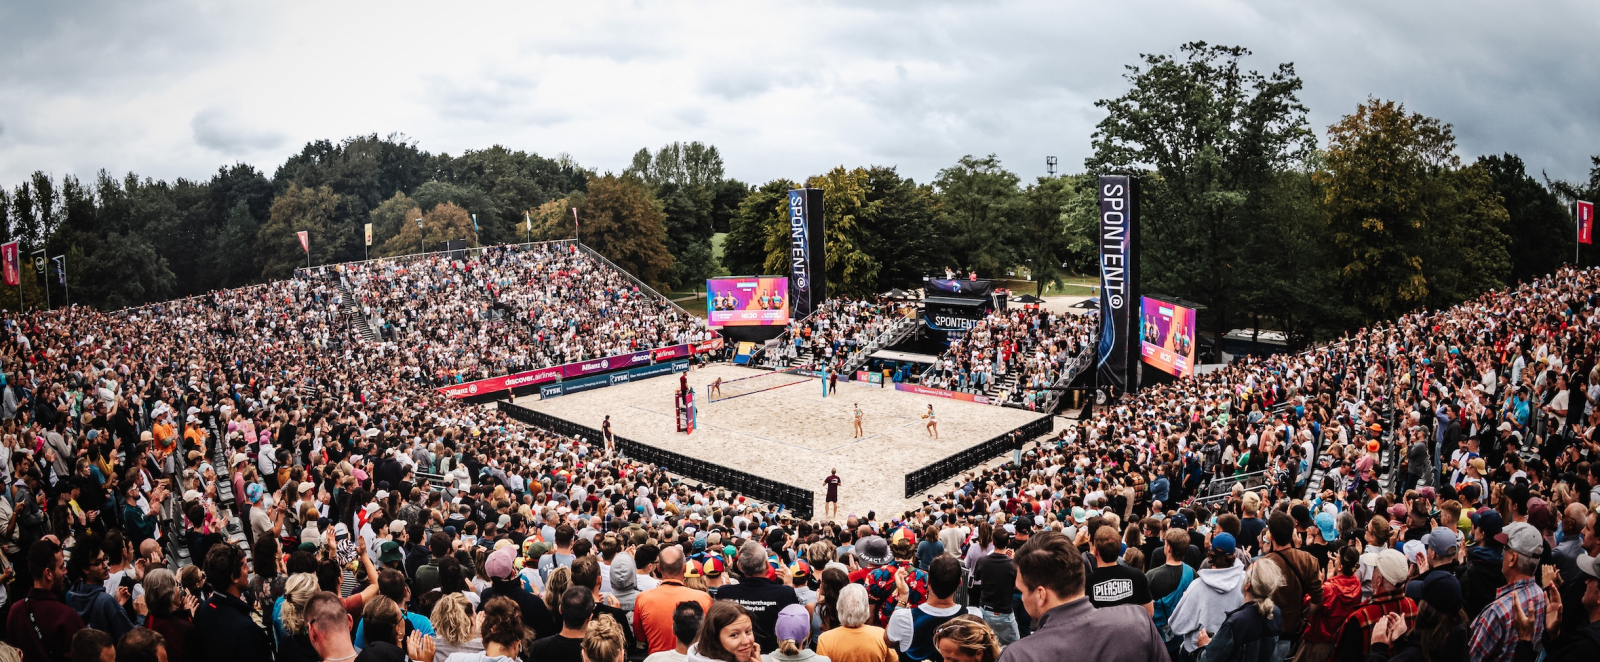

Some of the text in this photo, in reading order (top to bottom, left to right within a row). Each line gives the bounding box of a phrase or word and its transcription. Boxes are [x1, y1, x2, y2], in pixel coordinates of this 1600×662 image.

[582, 363, 601, 371] Allianz
[614, 374, 628, 382] JYSK
[545, 387, 561, 396] JYSK
[859, 552, 881, 563] IMPACT
[1095, 581, 1131, 596] PLEASURE
